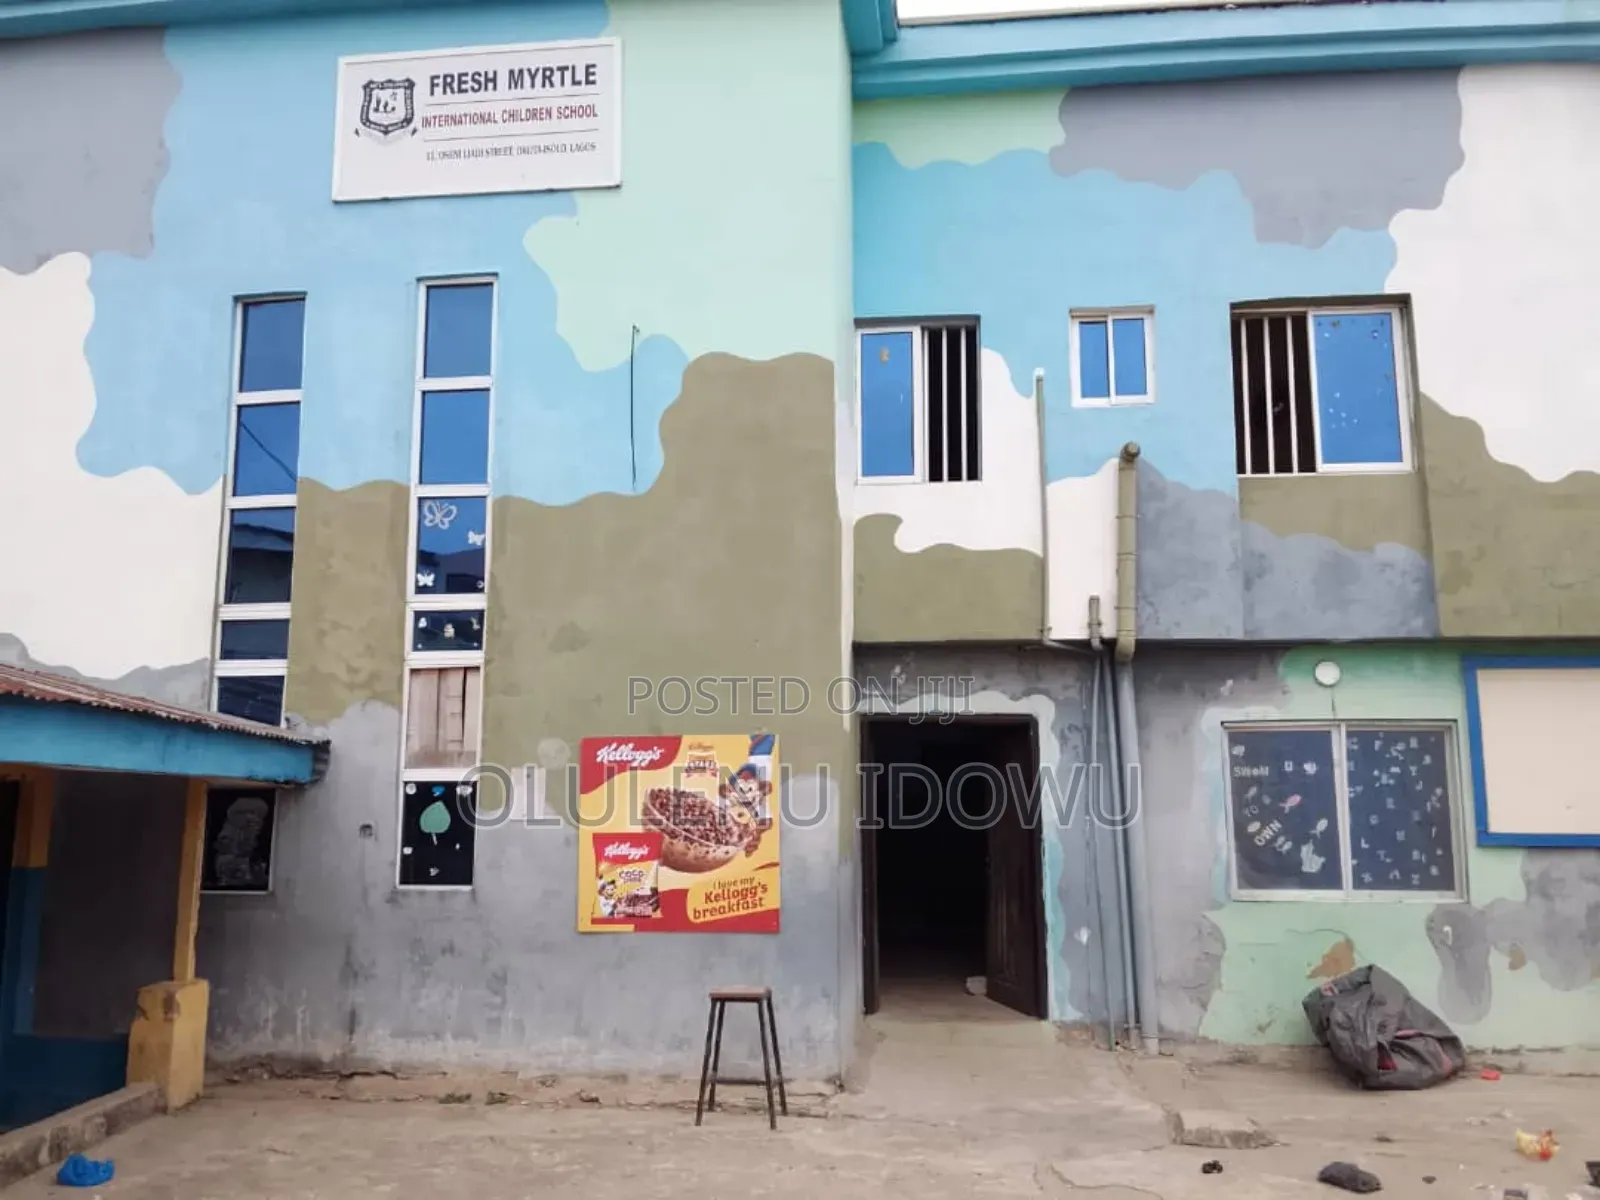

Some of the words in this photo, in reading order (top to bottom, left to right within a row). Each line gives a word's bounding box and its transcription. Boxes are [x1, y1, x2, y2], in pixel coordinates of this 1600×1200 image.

[429, 70, 498, 97] FRESH
[508, 63, 597, 90] MYRTLE
[421, 111, 498, 129] INTERNATIONAL
[501, 106, 552, 124] CHILDREN
[556, 104, 598, 120] SCHOOL
[596, 742, 665, 767] Kellogg's
[704, 880, 769, 904] Kellogg's
[692, 896, 764, 920] breakfast
